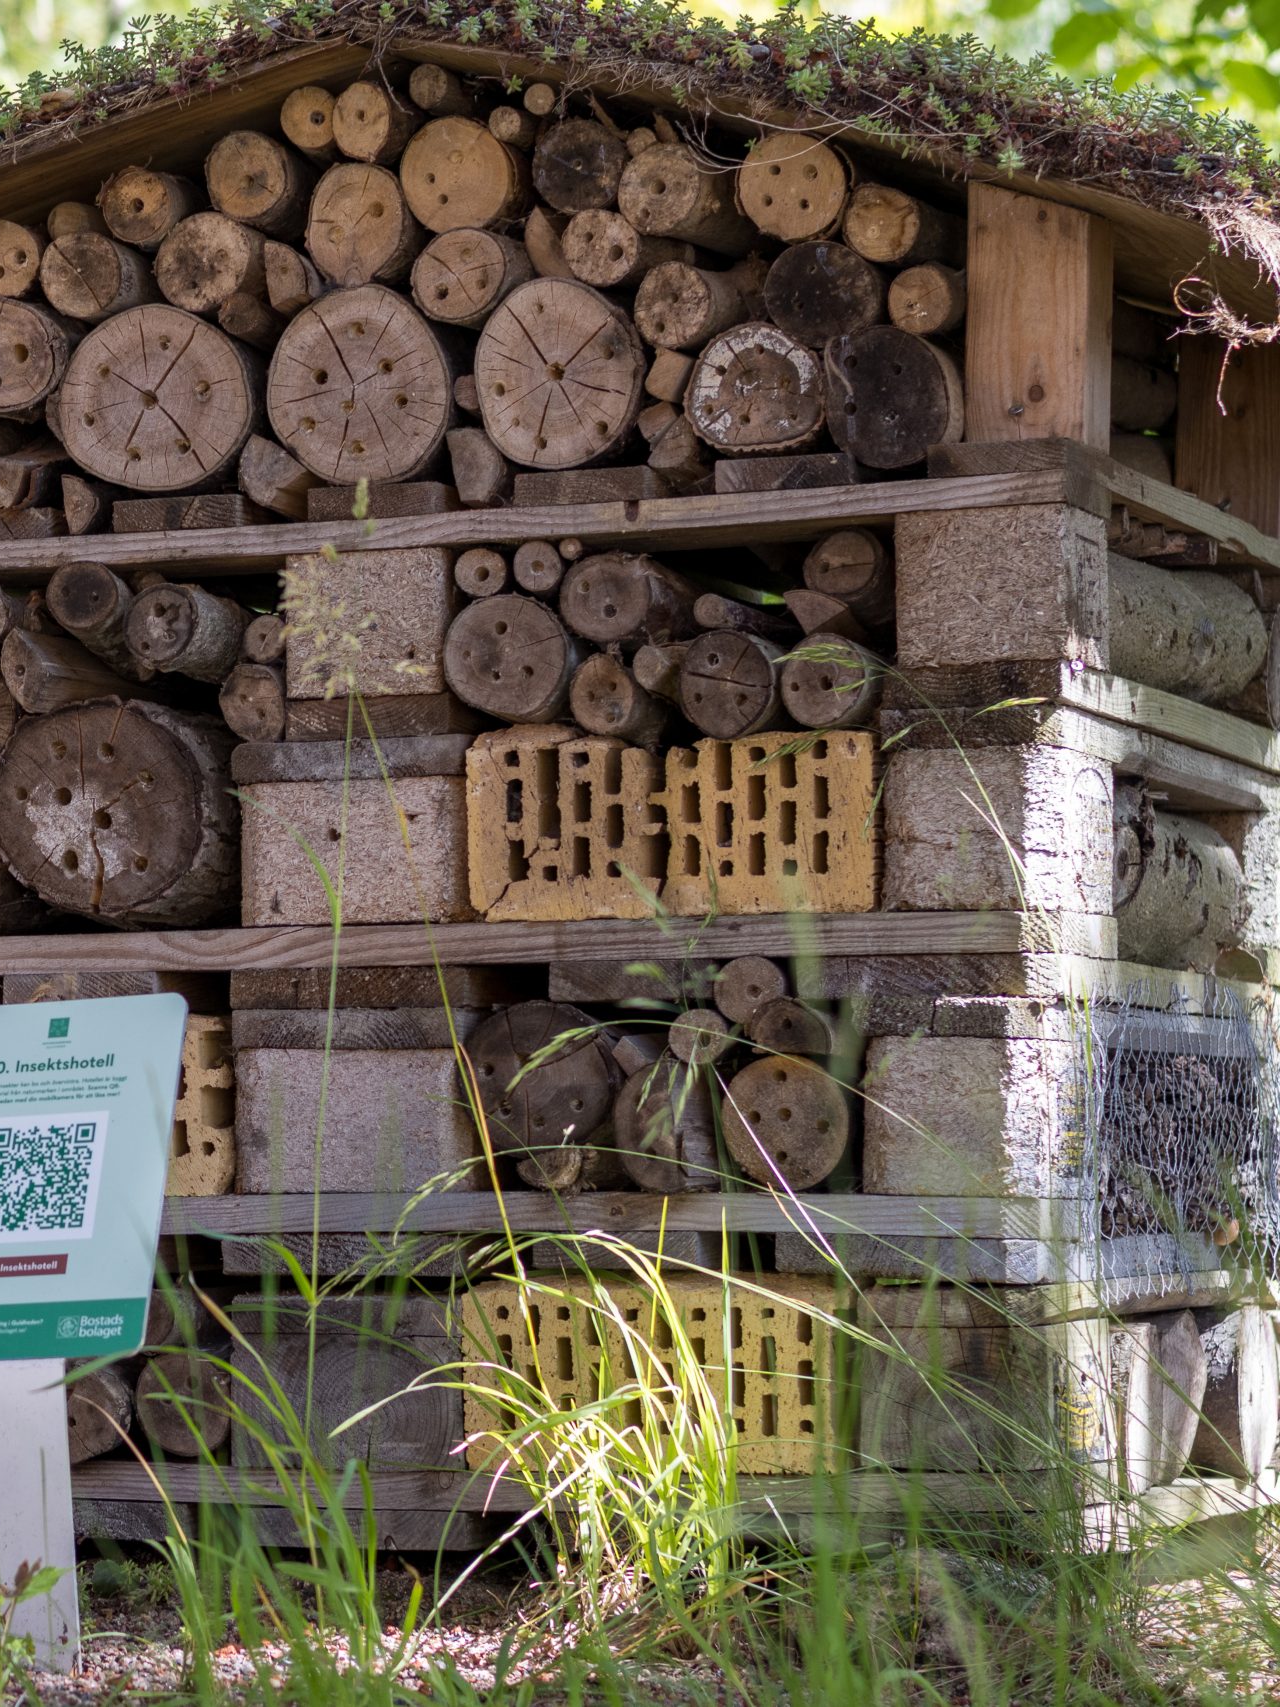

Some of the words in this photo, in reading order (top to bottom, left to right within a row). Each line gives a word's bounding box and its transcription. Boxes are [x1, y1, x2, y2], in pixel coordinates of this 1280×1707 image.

[15, 1053, 114, 1073] Insektshotell
[0, 1260, 58, 1273] Insektshotell
[80, 1315, 124, 1326] Bostads
[79, 1327, 122, 1339] bolaget
